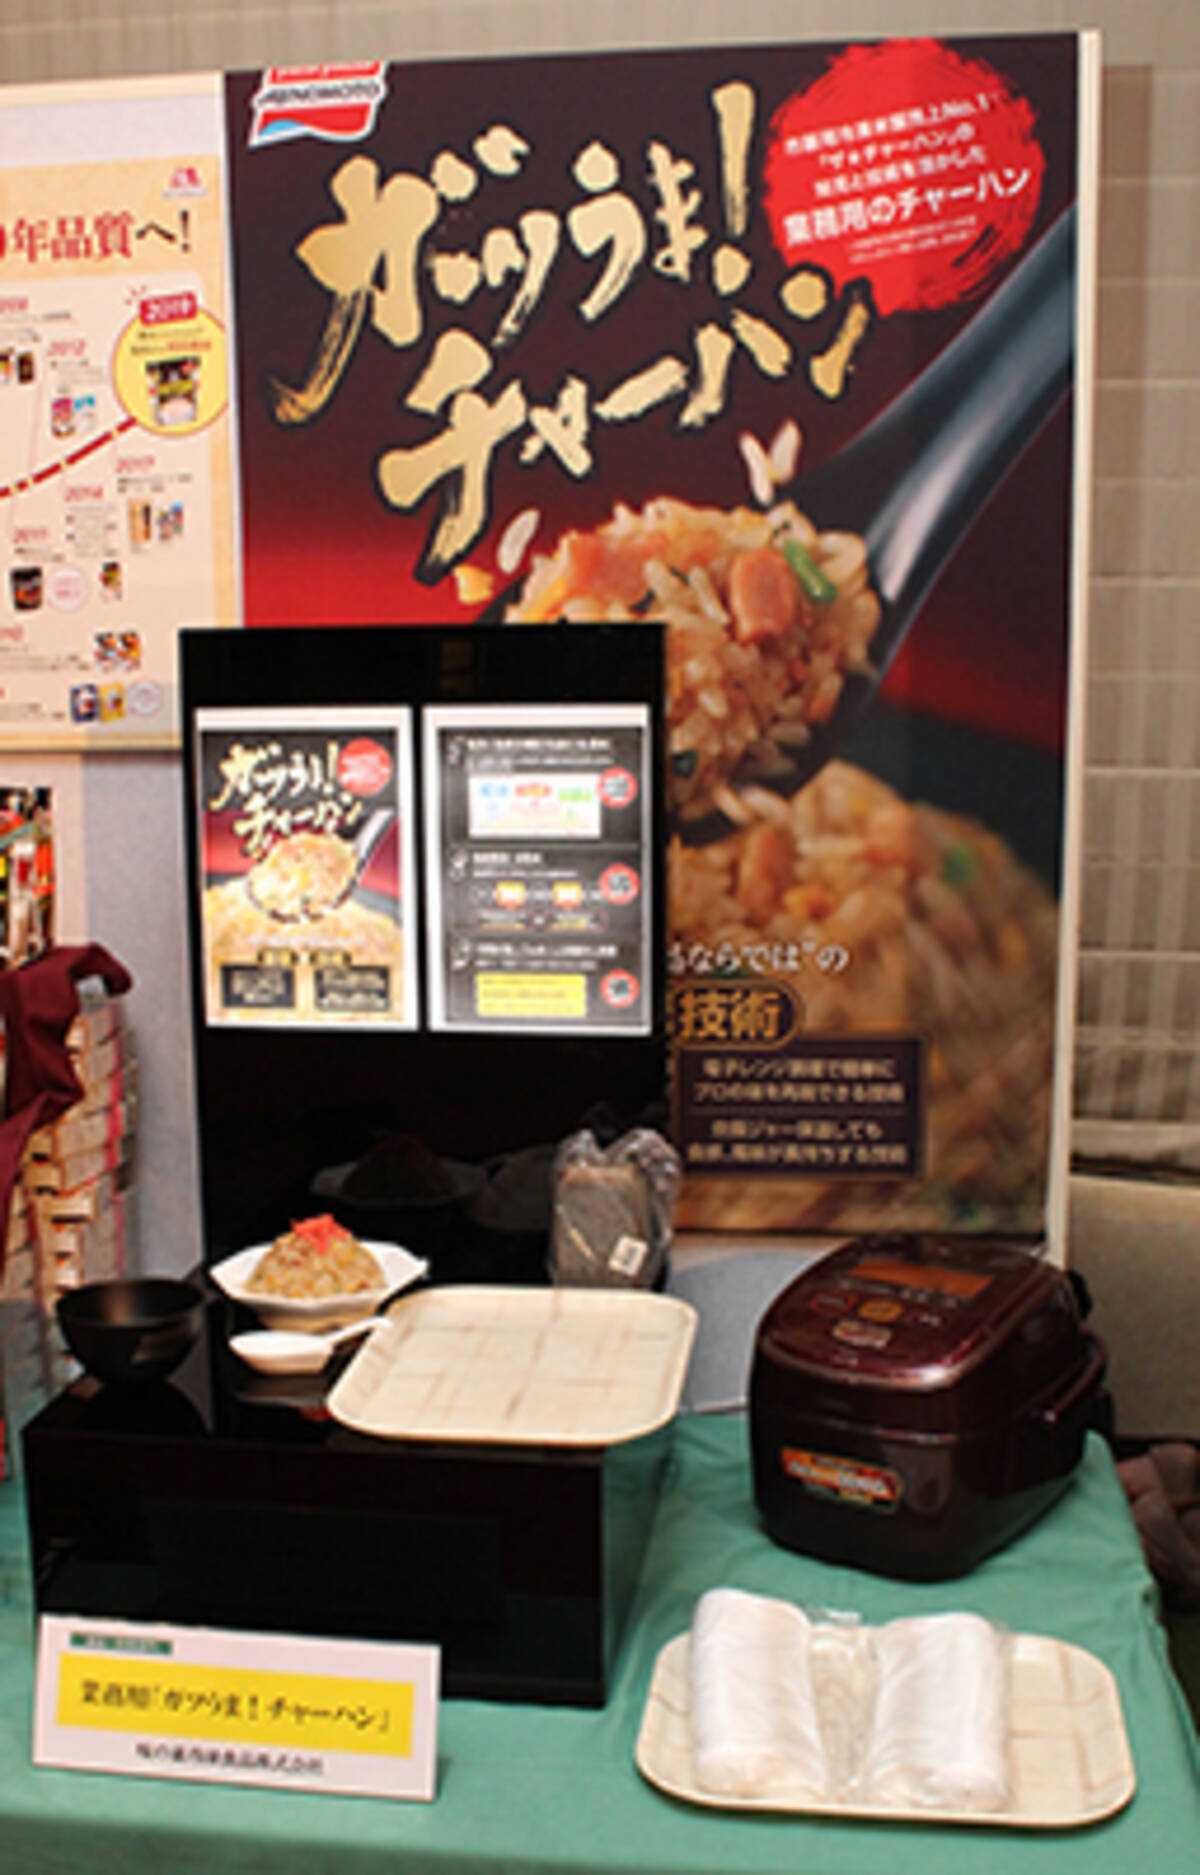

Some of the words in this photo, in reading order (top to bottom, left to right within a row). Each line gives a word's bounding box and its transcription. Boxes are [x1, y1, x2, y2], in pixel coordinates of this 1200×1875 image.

[270, 80, 758, 425] ガツうま!
[783, 168, 1031, 246] 業務用のチャーハン
[378, 272, 870, 575] チャーハン
[678, 990, 780, 1038] 技術
